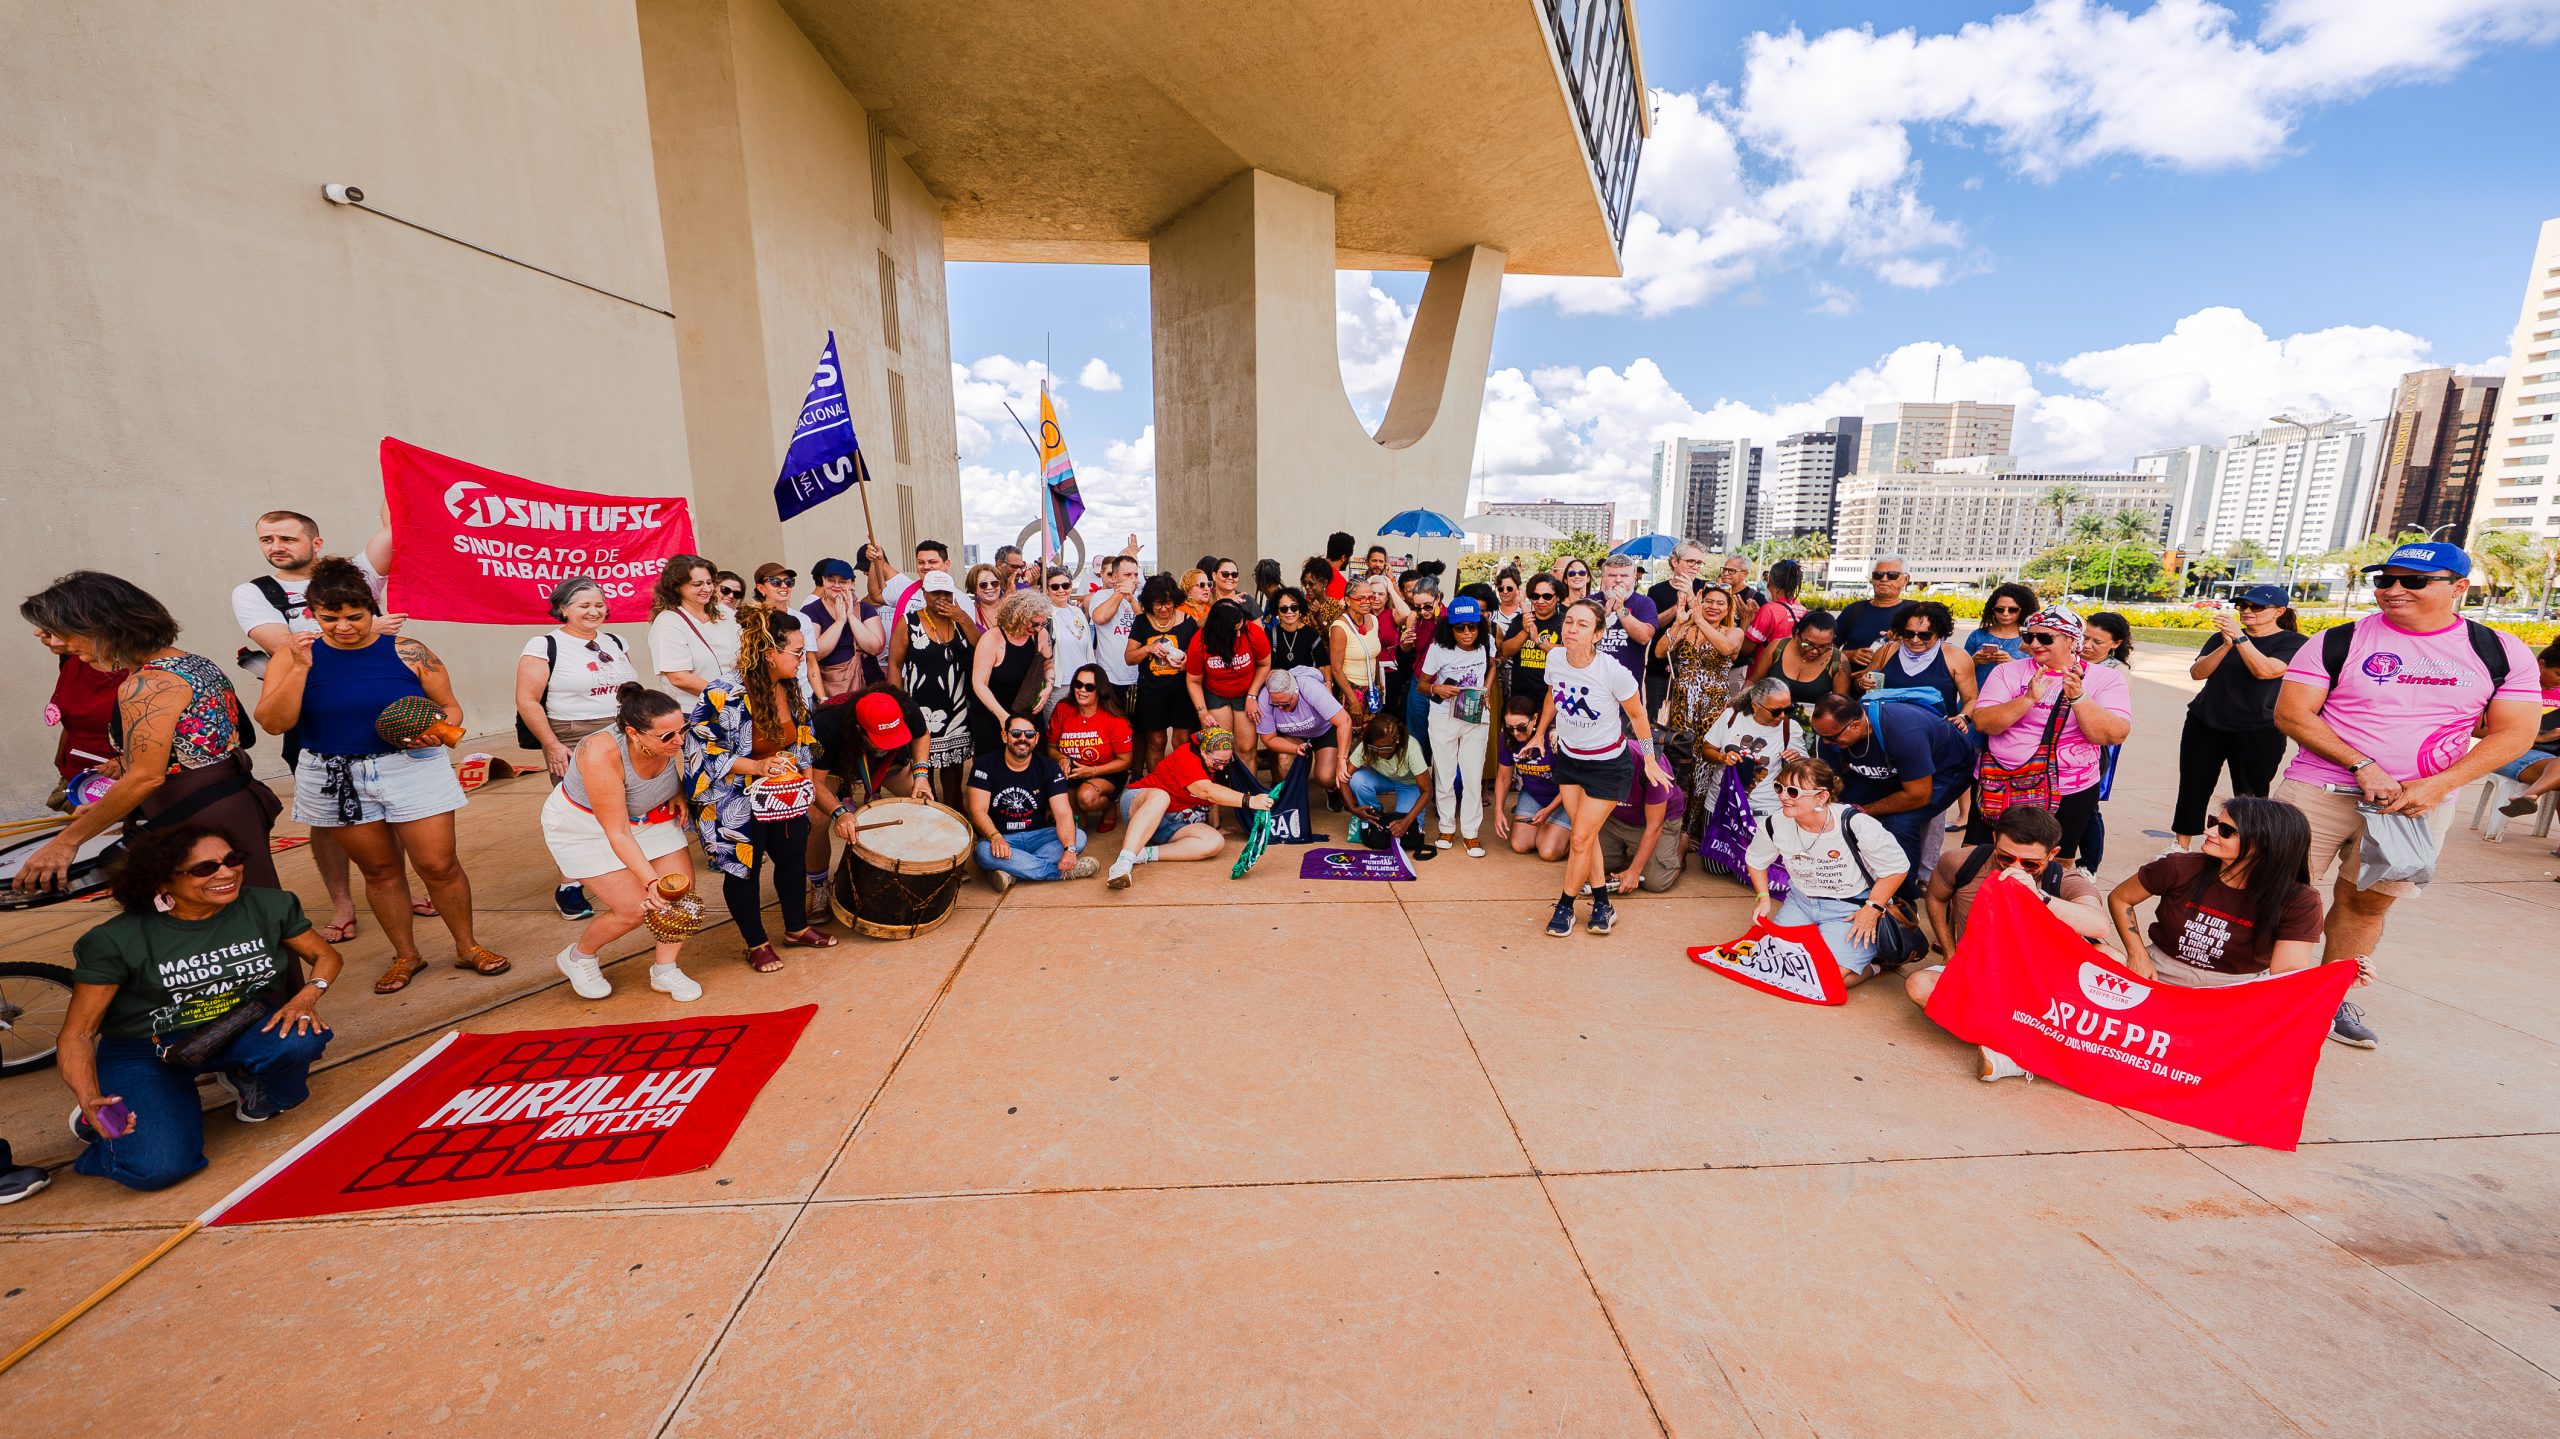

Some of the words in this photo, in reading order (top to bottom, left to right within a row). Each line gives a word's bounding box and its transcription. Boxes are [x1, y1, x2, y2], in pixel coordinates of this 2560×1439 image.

[505, 497, 662, 532] SINTUFSC
[453, 534, 587, 564] SINDICATO
[595, 548, 620, 563] DE
[477, 557, 669, 581] TRABALHADORES
[1120, 618, 1133, 628] SO
[1601, 639, 1628, 647] LUTA
[162, 964, 223, 988] UNIDO
[2012, 1009, 2065, 1043] ASSOCIAÇÃO
[2065, 1037, 2081, 1051] DOS
[2081, 1041, 2152, 1071] PROFESSORES
[2152, 1063, 2168, 1078] DA
[2170, 1068, 2202, 1086] UFPR
[417, 1067, 717, 1129] MURALHA
[536, 1105, 688, 1140] ANTIFA
